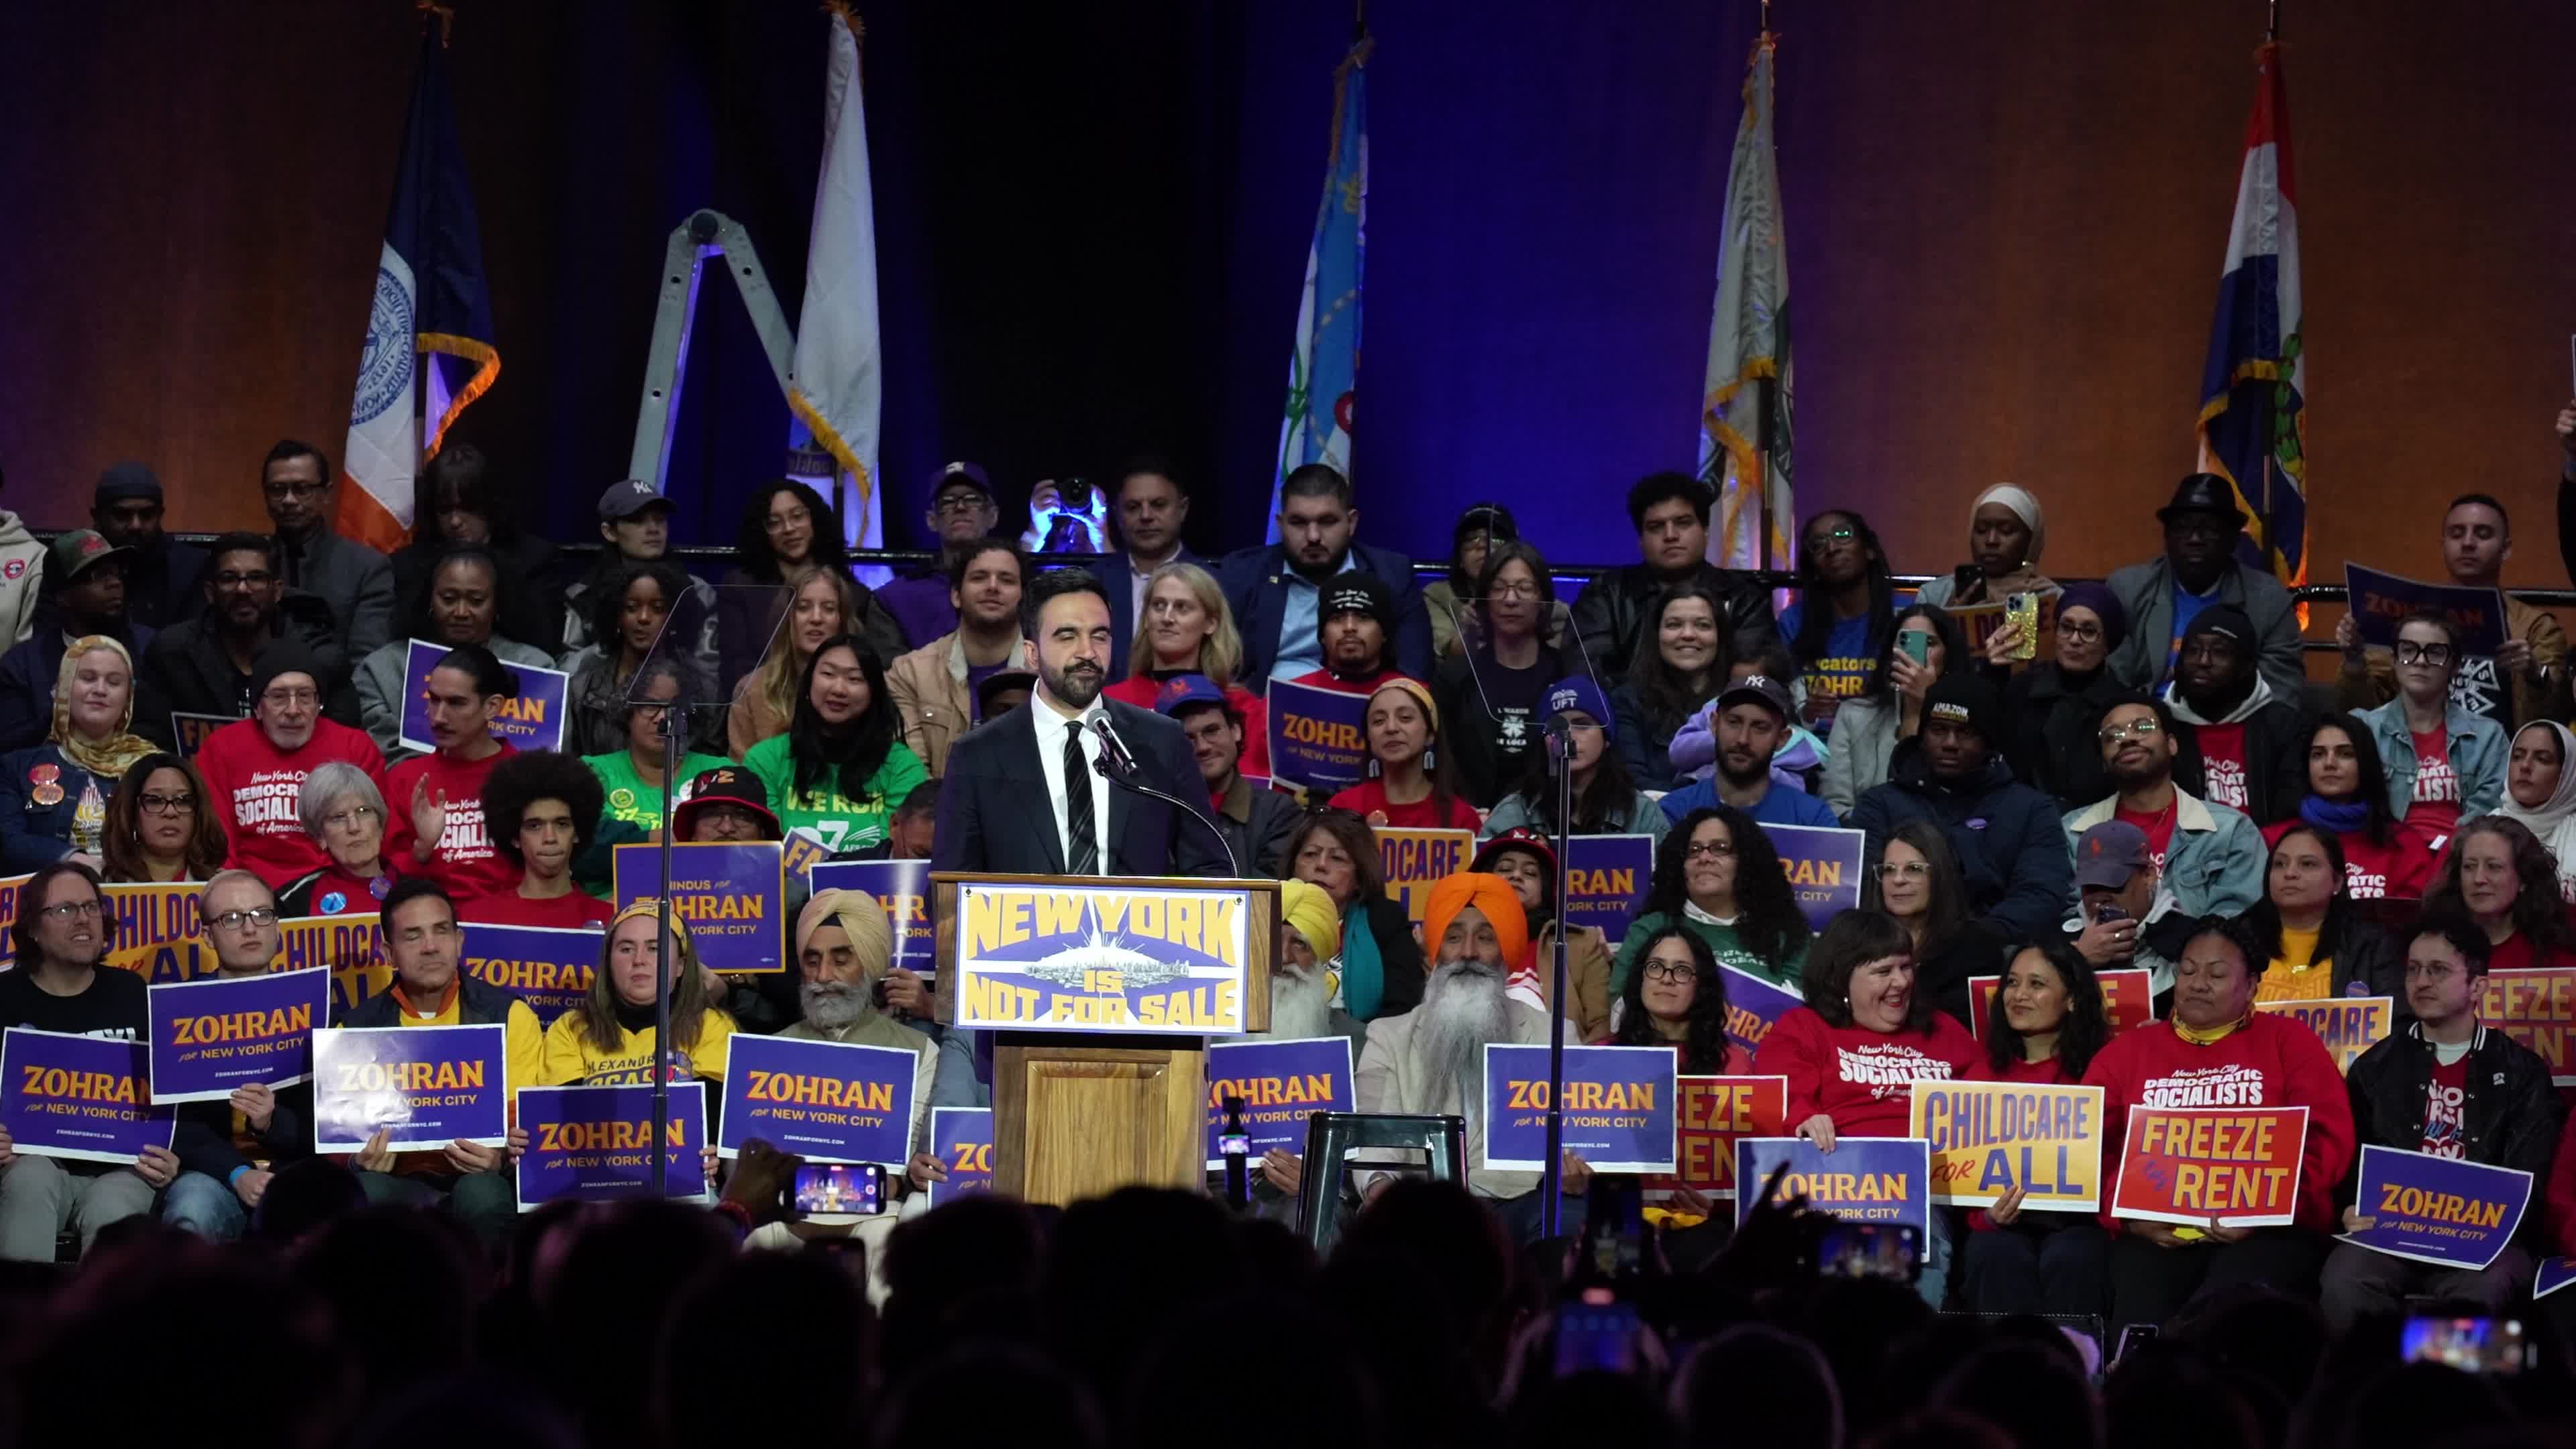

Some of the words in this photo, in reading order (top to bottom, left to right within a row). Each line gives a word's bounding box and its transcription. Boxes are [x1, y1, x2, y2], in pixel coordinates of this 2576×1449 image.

[1819, 656, 1878, 671] cators
[1745, 674, 1772, 688] NY
[1552, 697, 1576, 710] UFT
[488, 720, 503, 731] RK
[507, 724, 536, 736] CITY
[1282, 712, 1366, 751] ZOHR
[272, 770, 293, 782] York
[232, 783, 299, 802] DEMOCR
[1381, 838, 1463, 882] DCARE
[1566, 868, 1634, 896] RAN
[1777, 858, 1841, 886] RAN
[1567, 902, 1595, 912] ORK
[1597, 901, 1628, 911] CITY
[1802, 891, 1832, 902] CITY
[104, 894, 201, 955] HILDC
[691, 925, 724, 935] YORK
[727, 924, 757, 934] CITY
[906, 928, 932, 938] ORK
[1083, 969, 1124, 994] IS
[526, 995, 561, 1006] YORK
[565, 998, 586, 1008] CIT
[965, 971, 1040, 1022] NOT
[1051, 994, 1127, 1024] FOR
[1139, 979, 1236, 1026] SALE
[2474, 977, 2573, 1020] EEZE
[172, 1003, 311, 1046] ZOHRAN
[201, 1046, 233, 1059] NEW
[237, 1042, 273, 1056] YORK
[276, 1036, 305, 1051] CITY
[1837, 1046, 1951, 1067] DEMOCRATIC
[1858, 1045, 1883, 1054] New
[1882, 1043, 1904, 1055] York
[1904, 1046, 1925, 1057] City
[337, 1060, 484, 1092] ZOHRAN
[2144, 1068, 2264, 1089] DEMOCRATIC
[405, 1095, 441, 1107] YORK
[444, 1095, 477, 1106] CITY
[747, 1070, 894, 1112] ZOHRAN
[1210, 1073, 1334, 1108] OHRAN
[1507, 1081, 1654, 1111] ZOHRAN
[1870, 1086, 1884, 1099] of
[2142, 1081, 2263, 1108] SOCIALISTS
[46, 1104, 78, 1116] NEW
[82, 1107, 118, 1120] YORK
[772, 1109, 805, 1121] NEW
[809, 1112, 847, 1125] YORK
[850, 1116, 883, 1128] CITY
[1221, 1114, 1252, 1126] NW
[1254, 1110, 1291, 1122] YORK
[1677, 1085, 1753, 1132] EZE
[1572, 1117, 1611, 1128] YORK
[1614, 1117, 1648, 1128] CITY
[1925, 1091, 2090, 1154] CHILDCARE
[537, 1118, 686, 1152] ZOHRAN
[2140, 1116, 2277, 1161] FREEZE
[566, 1156, 599, 1168] NEW
[604, 1155, 641, 1166] YORK
[645, 1154, 678, 1165] CY
[1978, 1145, 2083, 1195] ALL
[2171, 1164, 2290, 1209] RENT
[1867, 1208, 1900, 1218] CITY
[2379, 1183, 2508, 1229] ZOHRAN
[2398, 1221, 2425, 1234] NEW
[2428, 1225, 2459, 1238] YORK
[2459, 1229, 2487, 1241] CITY
